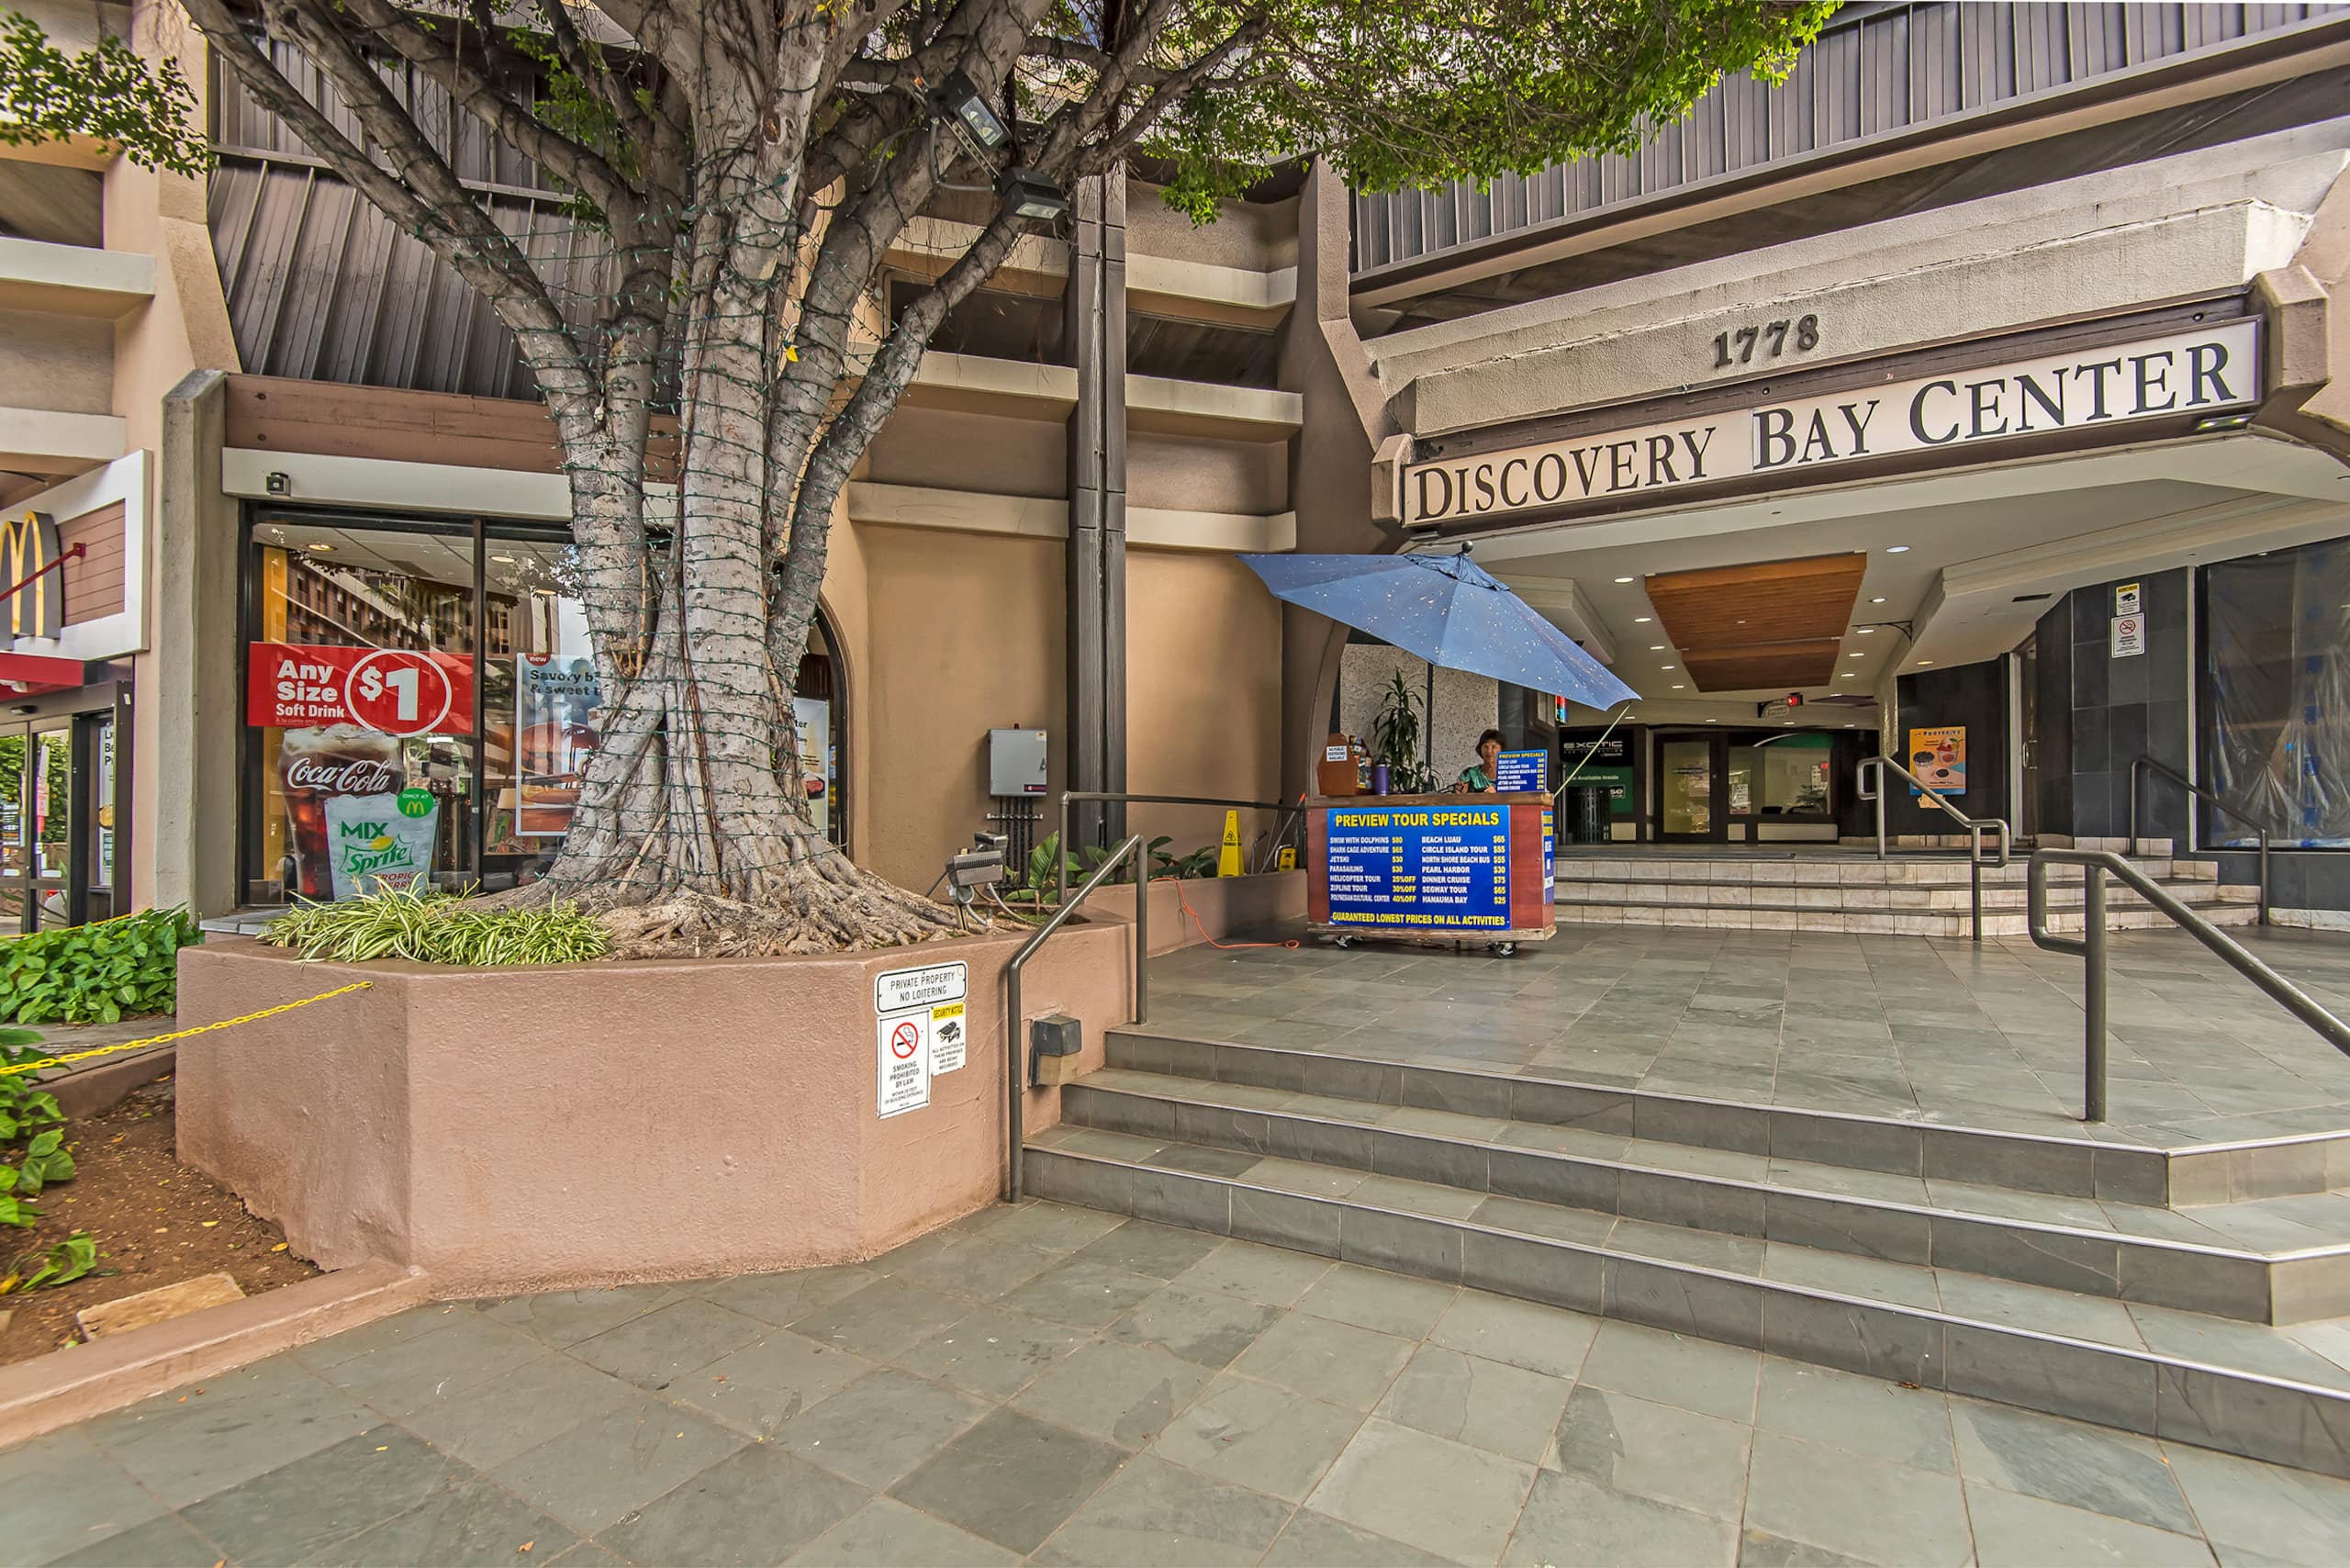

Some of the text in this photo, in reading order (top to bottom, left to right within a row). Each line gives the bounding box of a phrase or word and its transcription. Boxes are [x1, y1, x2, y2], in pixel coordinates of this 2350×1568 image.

[1713, 314, 1819, 367] 1778
[1414, 342, 2238, 521] DISCOVERY BAY CENTER
[277, 660, 334, 684] Any
[530, 669, 581, 684] Savory
[277, 681, 339, 703] Size
[359, 666, 419, 722] $1
[545, 686, 589, 696] sweet
[275, 703, 345, 718] Soft Drink
[287, 757, 392, 792] Coca-Cola
[1336, 812, 1500, 827] PREVIEW TOUR SPECIALS
[341, 821, 389, 839] MIX
[346, 841, 408, 875] Sprite
[1332, 912, 1505, 925] GUARANTEED LOWEST PRICES ON ALL ACTIVITIES
[890, 971, 956, 991] PRIVATE PROPERTY
[900, 985, 947, 1002] NO LOITERING
[890, 1068, 920, 1081] PROHIBITED
[892, 1060, 917, 1072] SMOKING
[902, 1078, 914, 1086] LAW
